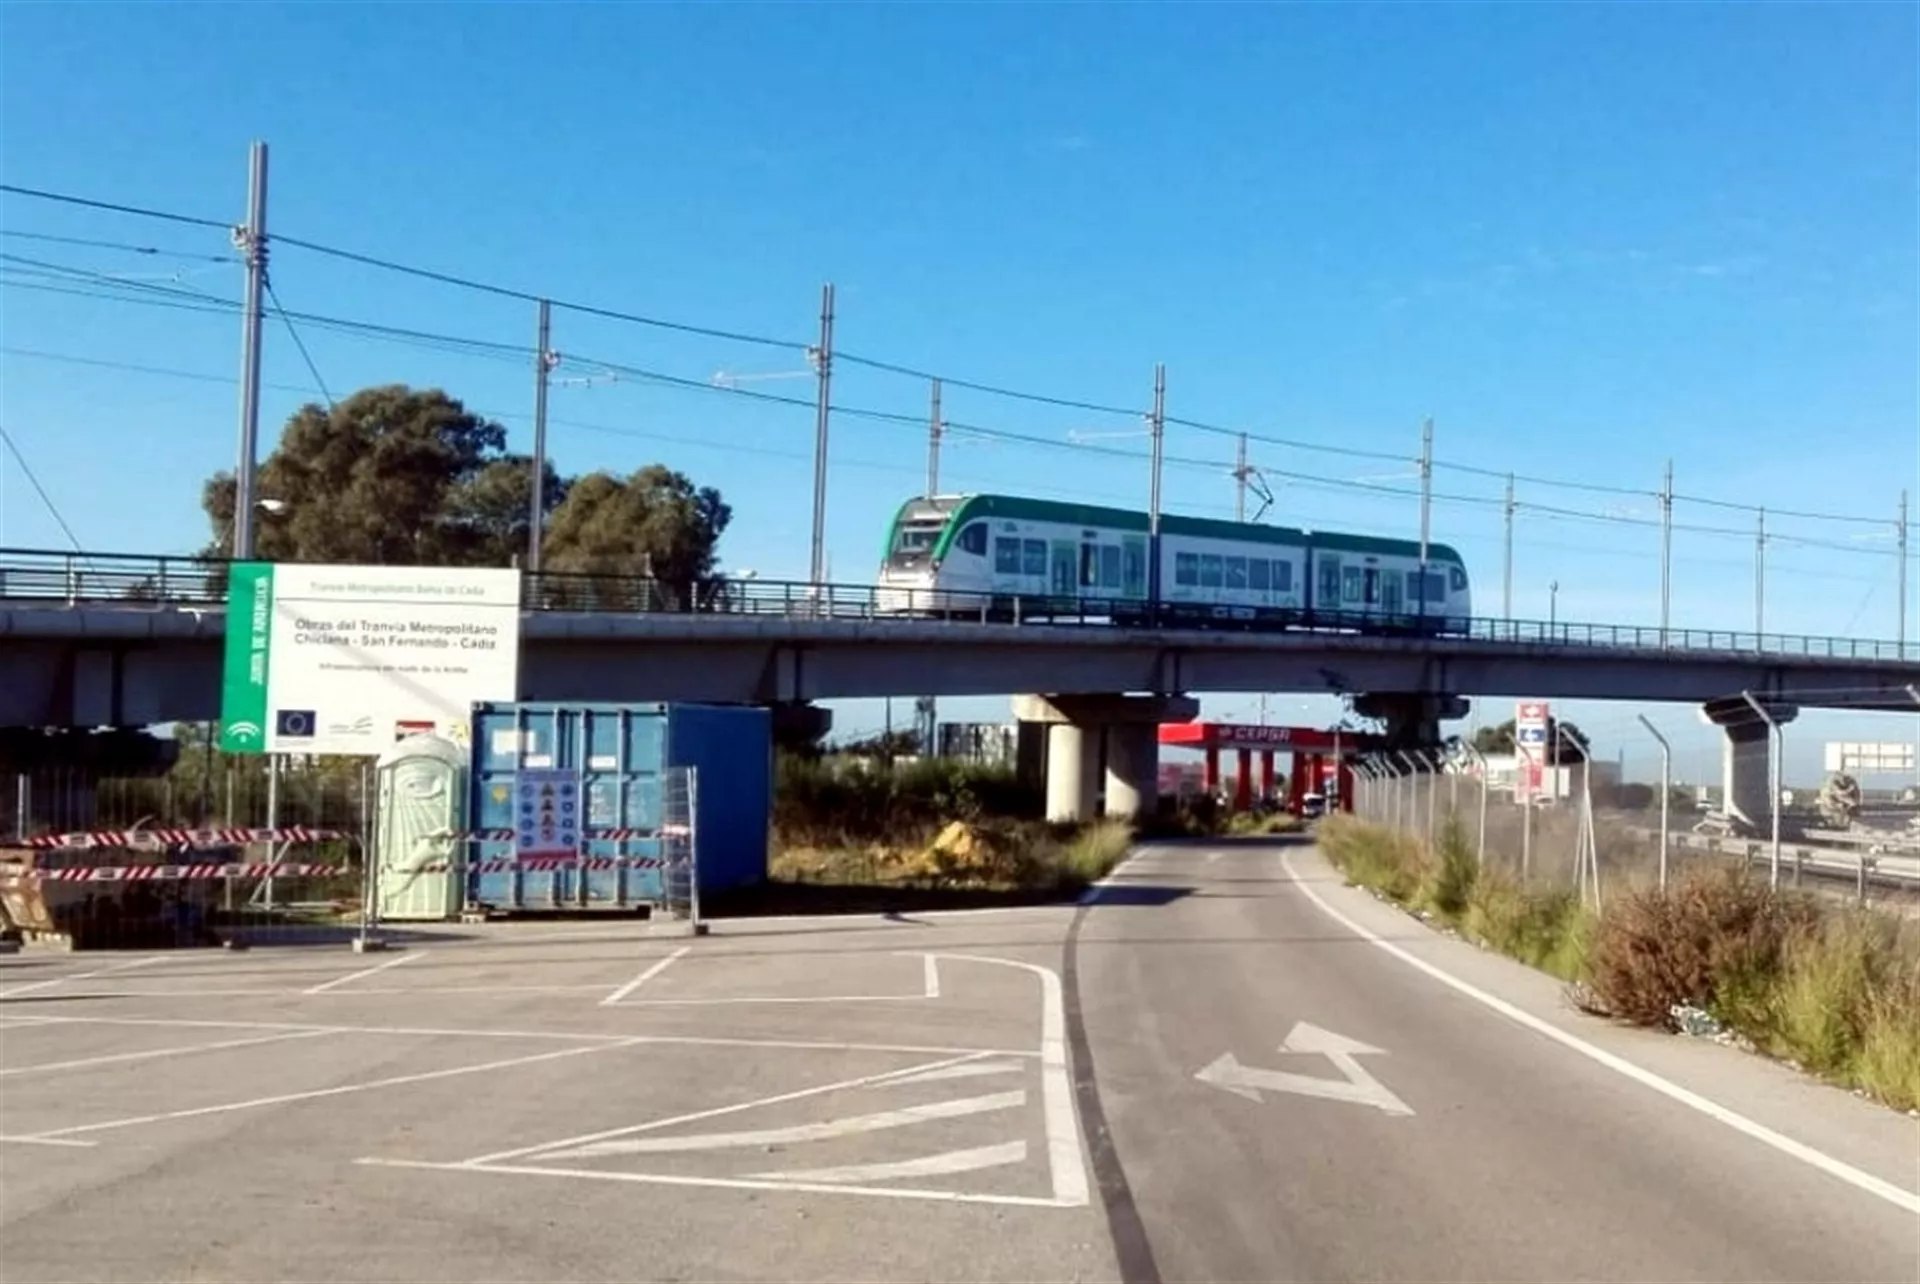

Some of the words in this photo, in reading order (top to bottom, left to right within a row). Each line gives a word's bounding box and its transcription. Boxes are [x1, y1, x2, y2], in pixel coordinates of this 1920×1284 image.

[294, 618, 334, 631] Obras
[337, 619, 357, 631] del
[409, 621, 497, 636] Metropolitano
[252, 636, 266, 650] DE
[294, 632, 350, 645] Chiclana
[362, 634, 385, 647] San
[389, 635, 449, 649] Fernando
